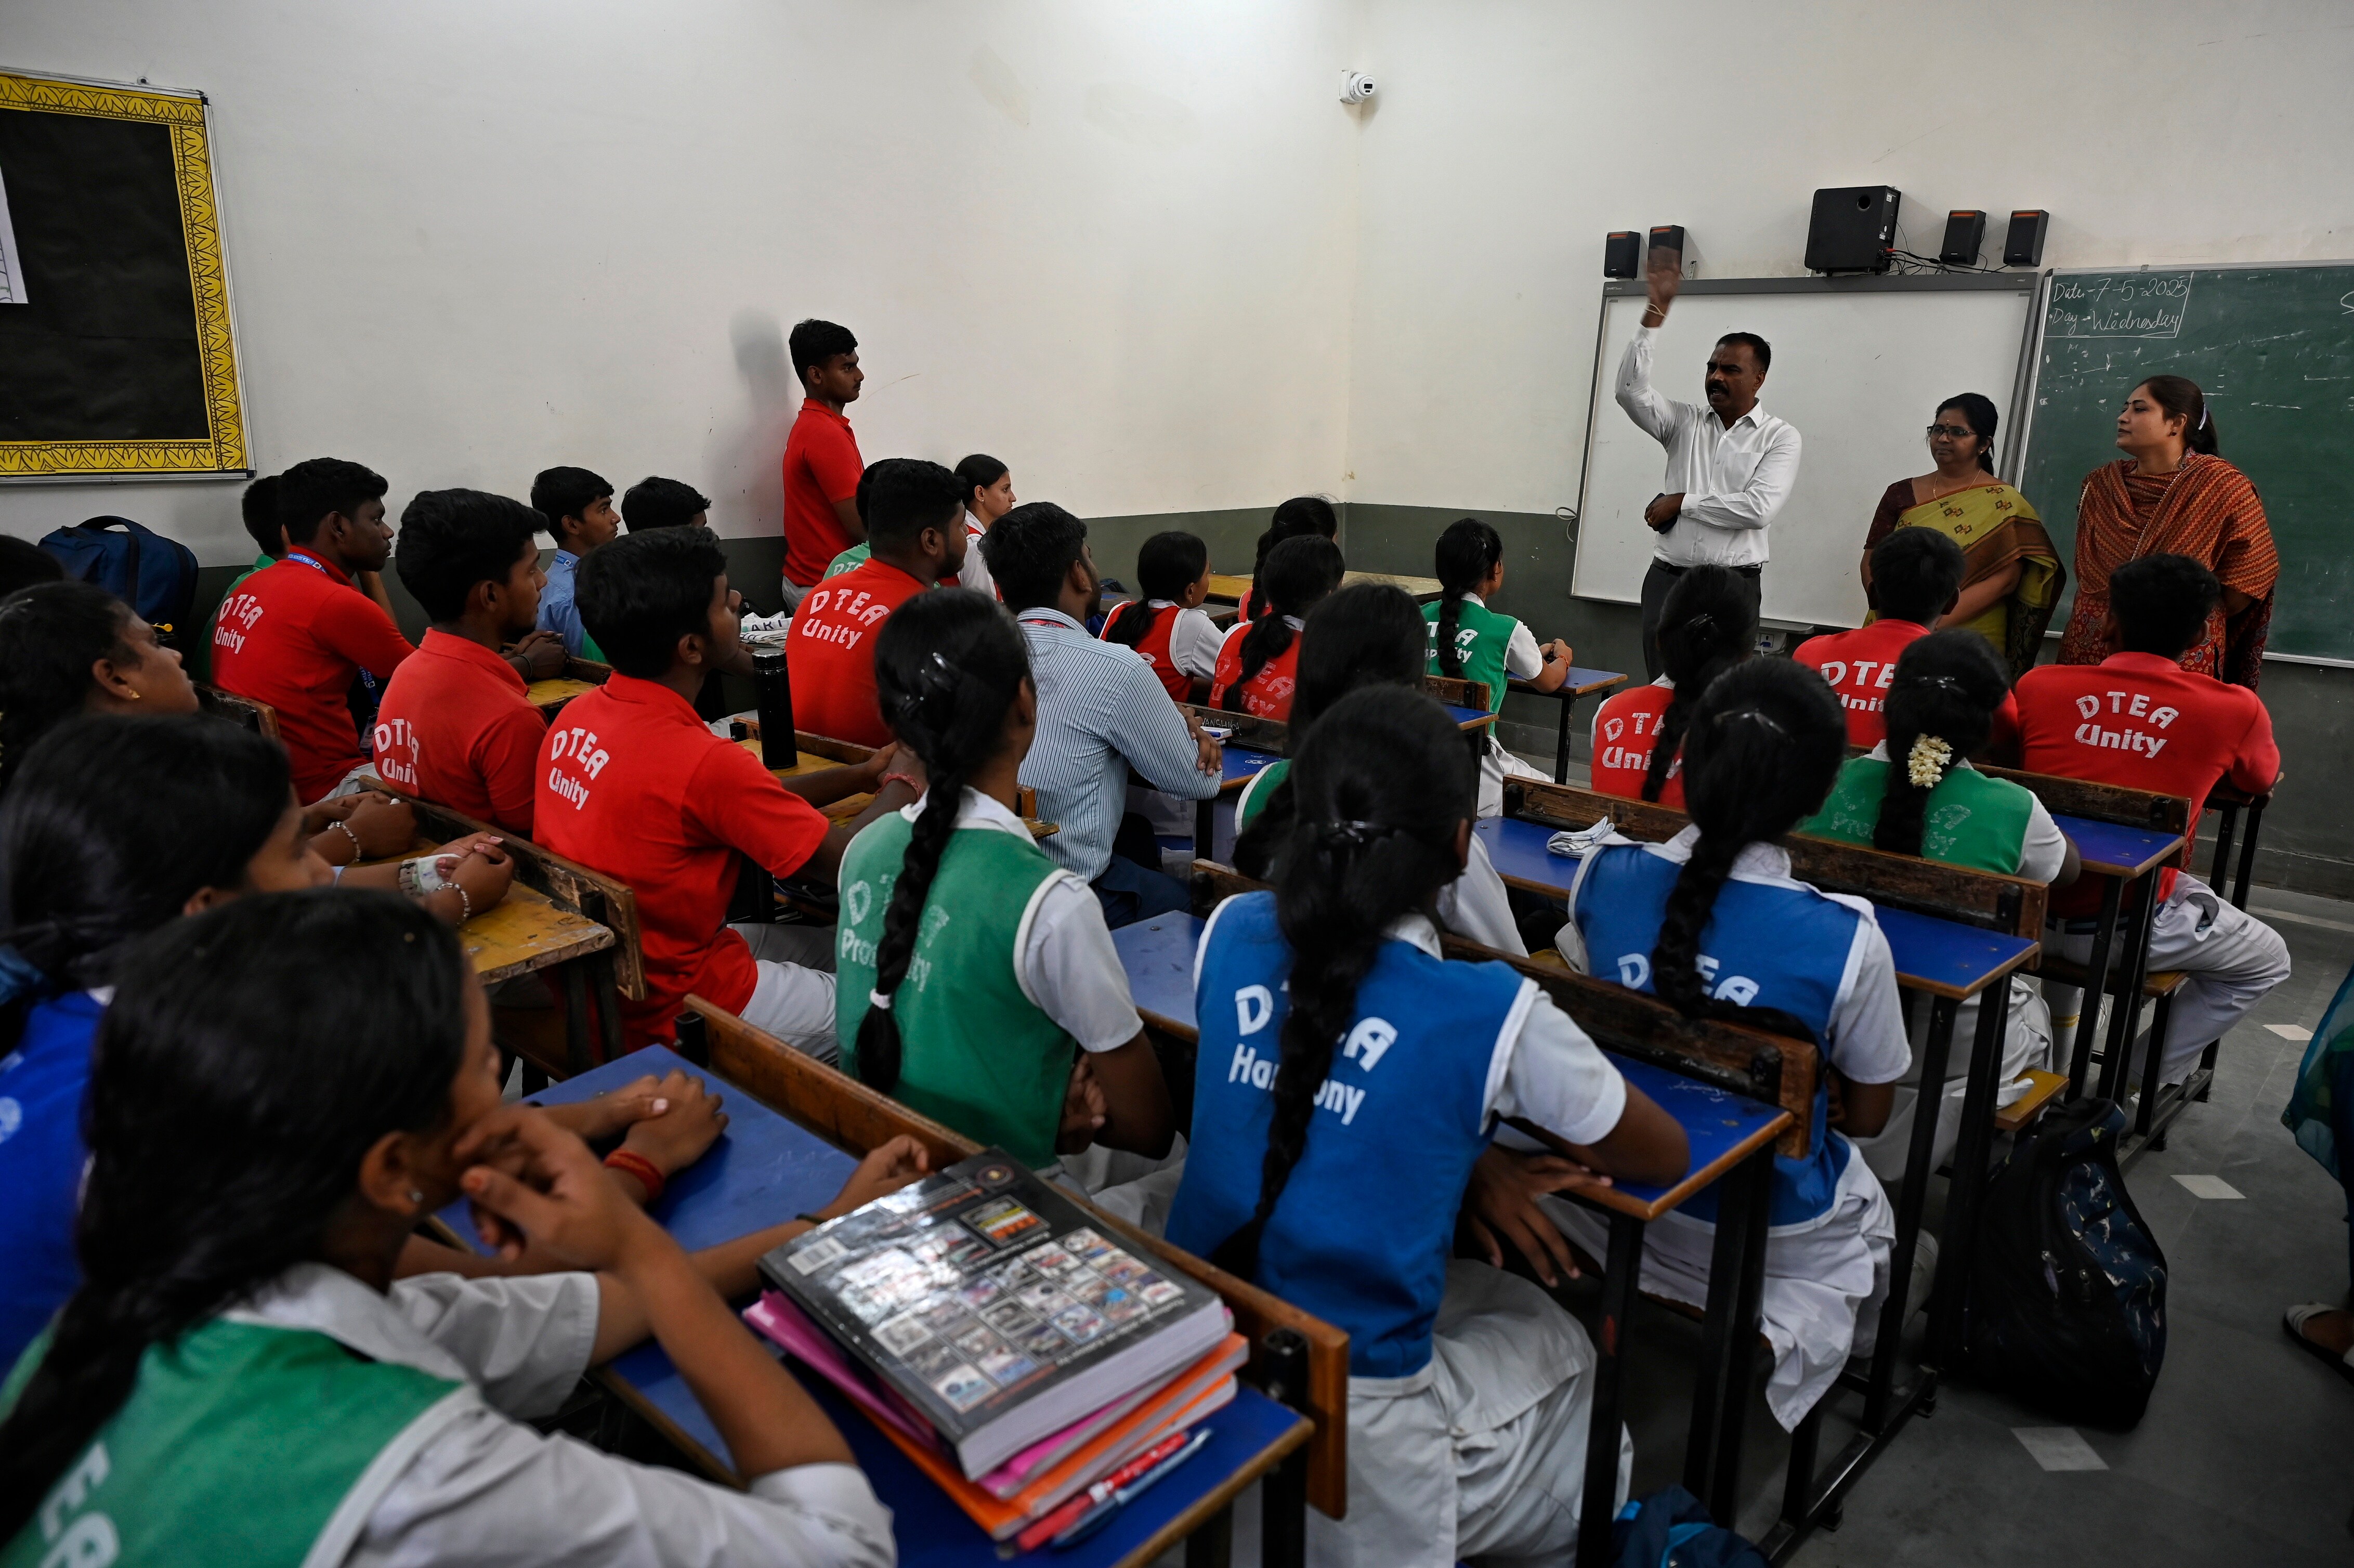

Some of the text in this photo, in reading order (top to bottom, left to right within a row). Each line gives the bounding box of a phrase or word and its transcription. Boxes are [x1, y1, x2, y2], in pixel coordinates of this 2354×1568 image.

[219, 594, 264, 631] DTEA
[809, 589, 890, 627] DTEA
[215, 626, 246, 655] Unity
[802, 618, 863, 650] Unity
[1820, 660, 1897, 689] DTE
[1211, 683, 1276, 717] Uity
[2076, 691, 2179, 729] DTEA
[551, 727, 610, 781] DTEA
[2074, 723, 2167, 759] Unity
[548, 767, 590, 811] Unity
[1617, 952, 1760, 1008] DEA
